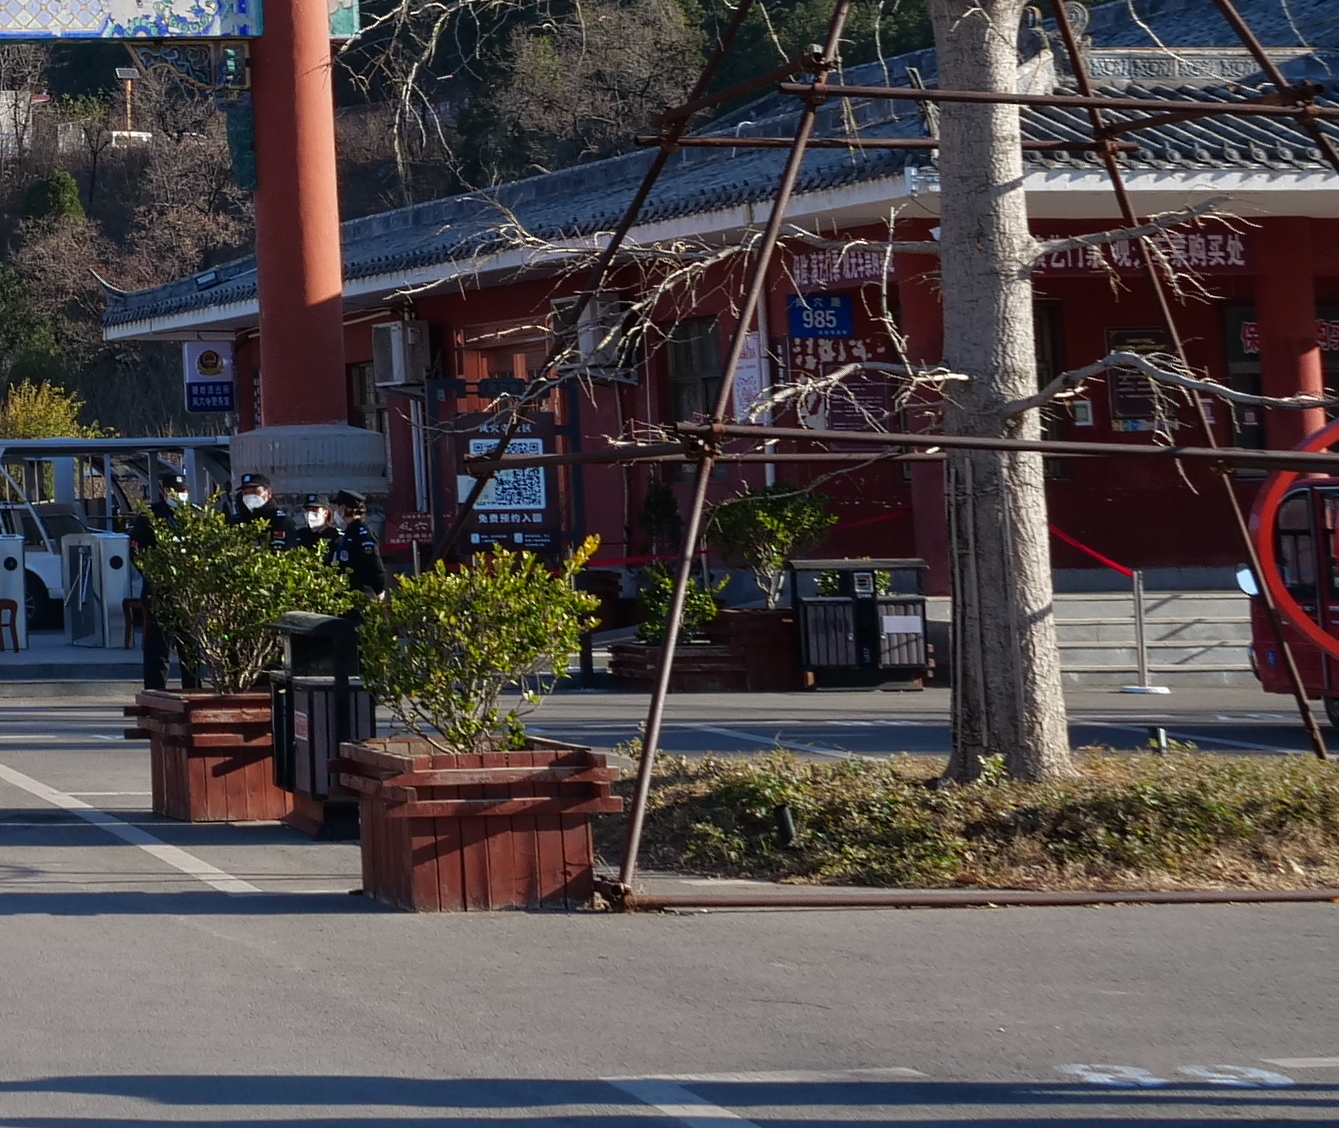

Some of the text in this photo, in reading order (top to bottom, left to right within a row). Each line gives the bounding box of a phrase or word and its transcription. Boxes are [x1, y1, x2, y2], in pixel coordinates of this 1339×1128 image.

[1111, 233, 1246, 266] 观车票购买处
[802, 310, 837, 328] 985
